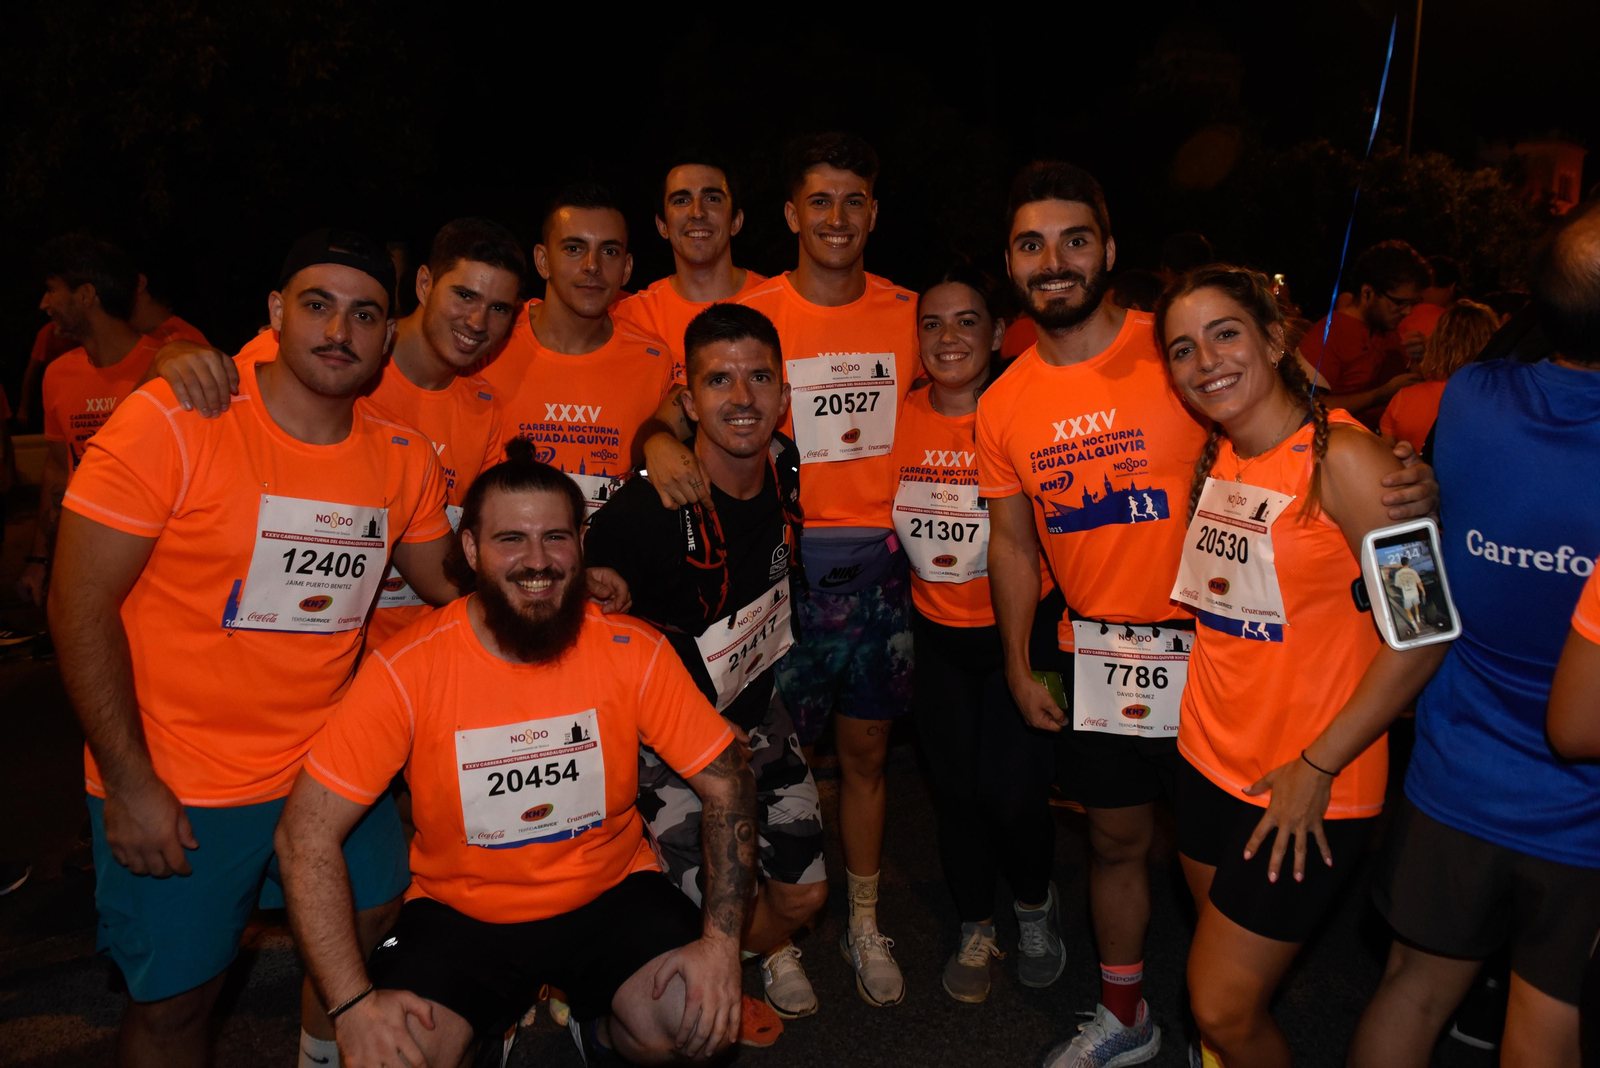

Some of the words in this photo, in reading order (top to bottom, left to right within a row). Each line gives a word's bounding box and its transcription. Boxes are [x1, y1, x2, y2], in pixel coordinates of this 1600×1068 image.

[544, 403, 602, 423] XXXV
[814, 392, 880, 416] 20527
[519, 423, 564, 432] CARRERA
[568, 424, 620, 435] NOCTURNA
[1052, 408, 1116, 442] XXXV
[526, 432, 619, 446] GUADALQUIVIR
[1030, 442, 1078, 460] CARRERA
[1082, 428, 1144, 446] NOCTURNA
[921, 450, 976, 467] XXXV
[1038, 440, 1146, 471] GUADALQUIVIR
[900, 466, 938, 475] CARRERA
[911, 518, 979, 543] 21307
[1196, 525, 1248, 564] 20530
[1466, 529, 1598, 577] Carrefo
[283, 548, 366, 579] 12406
[827, 563, 861, 579] NIKE
[1242, 607, 1278, 616] Cruzcampo
[729, 614, 777, 673] 21417
[1104, 662, 1168, 689] 7786
[539, 747, 574, 757] GUADALQUIVIR
[487, 759, 579, 796] 20454
[567, 810, 599, 823] Cruzcampo
